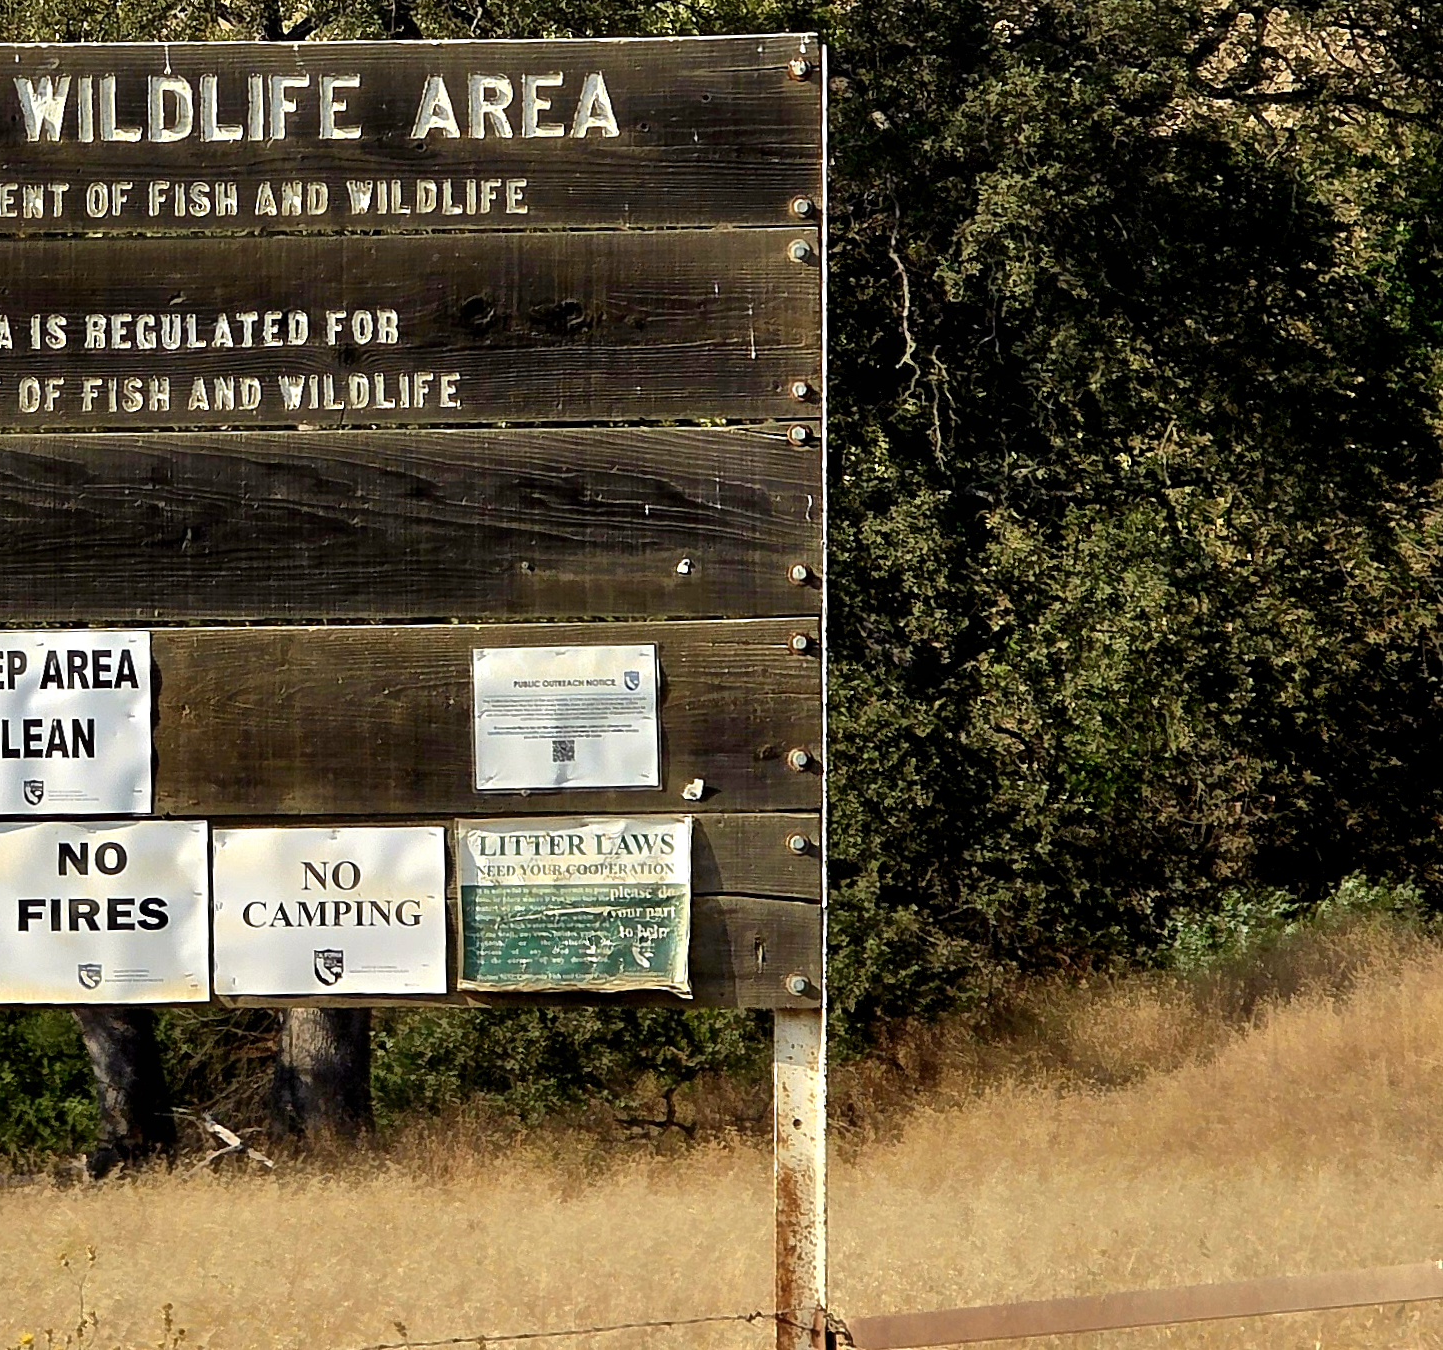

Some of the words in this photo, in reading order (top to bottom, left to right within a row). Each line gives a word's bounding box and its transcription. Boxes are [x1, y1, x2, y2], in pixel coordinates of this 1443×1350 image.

[13, 72, 361, 143] WILDLIFE
[411, 70, 620, 140] AREA
[86, 181, 133, 218] OF
[147, 180, 238, 217] FISH
[255, 179, 329, 216] AND
[347, 177, 529, 216] WILDLIFE
[30, 312, 67, 350] IS
[85, 310, 310, 350] REGULATED
[325, 309, 399, 346] FOR
[18, 375, 65, 414] OF
[80, 375, 171, 413] FISH
[187, 374, 262, 411] AND
[278, 371, 462, 411] WILDLIFE
[39, 648, 140, 690] AREA
[513, 679, 541, 688] PUBLIC
[542, 679, 585, 688] OUTREACH
[586, 678, 617, 687] NOTICE
[58, 841, 128, 876] NO
[478, 834, 587, 857] LITTER
[594, 833, 675, 856] LAWS
[300, 860, 362, 891] NO
[478, 864, 517, 878] NEED
[520, 863, 562, 877] YOUR
[565, 862, 675, 876] COOPERATION
[610, 885, 652, 901] please
[18, 897, 170, 932] FIRES
[241, 899, 423, 928] CAMPING
[646, 906, 676, 920] part
[619, 925, 634, 939] to
